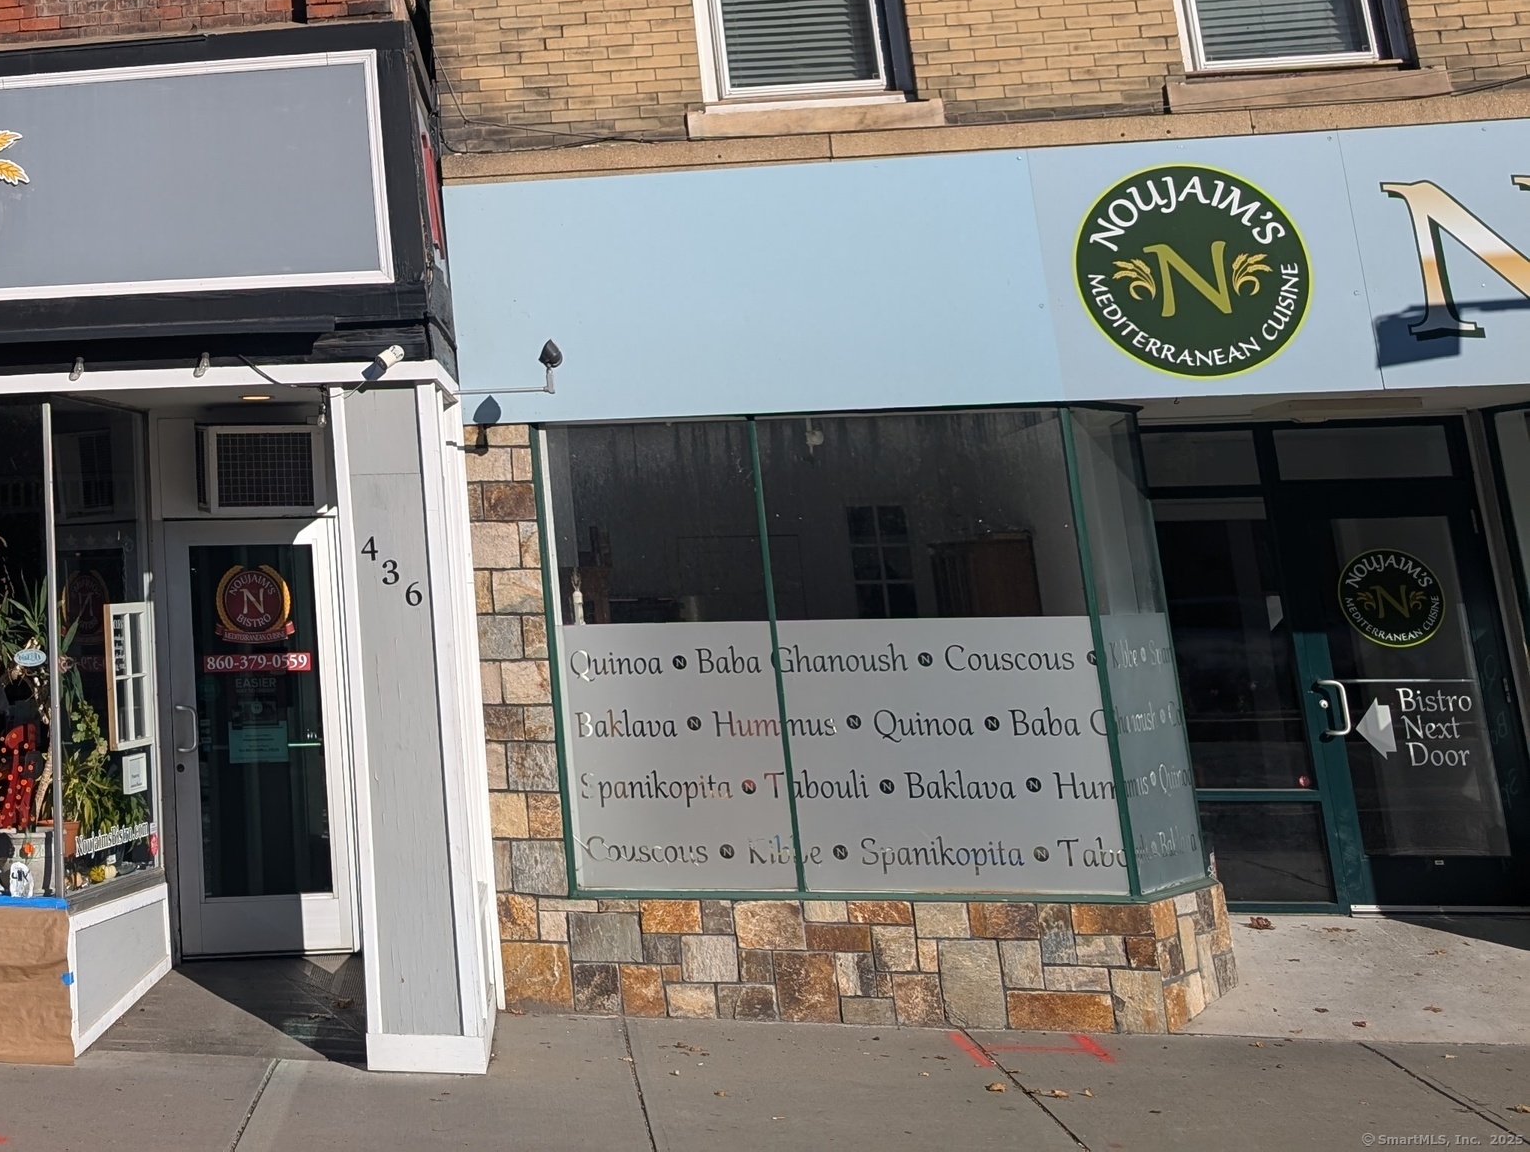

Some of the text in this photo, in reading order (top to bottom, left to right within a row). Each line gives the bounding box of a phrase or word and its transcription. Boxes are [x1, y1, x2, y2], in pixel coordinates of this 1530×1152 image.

[1090, 176, 1285, 251] NOUJAIM'S
[1143, 240, 1233, 318] N
[1087, 262, 1299, 367] MEDITERRANEAN CUISINE
[229, 574, 276, 595] NOUJAIM'S
[361, 536, 423, 606] 436
[1345, 554, 1433, 589] NOUJAIM'S
[240, 588, 265, 614] N
[1345, 595, 1439, 641] MEDITERRANEAN CUISINE
[1370, 585, 1410, 619] N
[236, 613, 271, 627] BISTRO
[207, 653, 308, 670] 860-379-0559
[570, 650, 663, 682] Quinoa
[695, 646, 762, 674] Baba
[771, 644, 908, 673] Ghanoush
[944, 644, 1075, 671] Couscous
[1109, 639, 1138, 669] Kbbe
[235, 677, 277, 689] EASIER
[1396, 688, 1472, 712] Bistro
[575, 709, 678, 737] Baklava
[712, 710, 836, 738] Hummus
[873, 709, 974, 743] Quinoa
[1008, 707, 1081, 736] Baba
[1401, 715, 1460, 739] Next
[1405, 742, 1470, 767] Door
[581, 770, 733, 808] Spanikopita
[764, 770, 870, 799] Tabouli
[905, 770, 1016, 799] Baklava
[75, 822, 149, 859] NoujaimsBistro.com
[587, 835, 709, 866] Couscous
[861, 836, 1024, 876] Spanikopita
